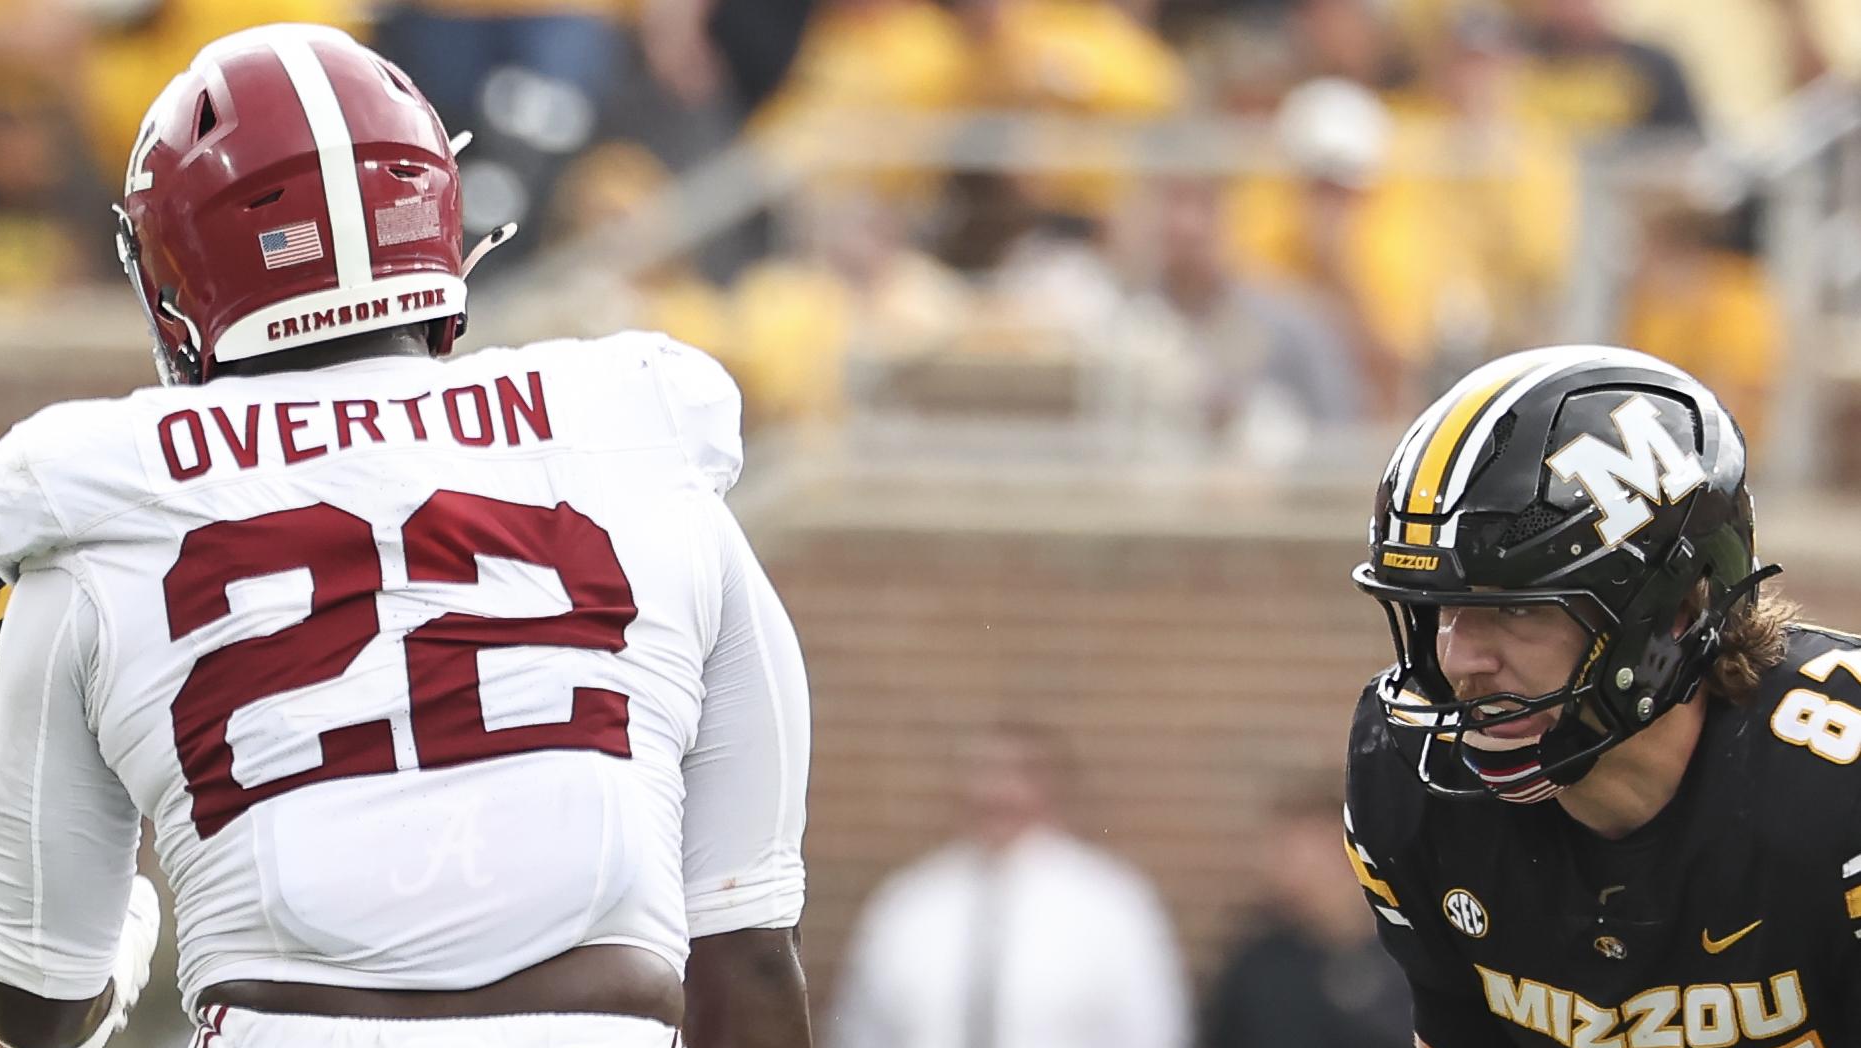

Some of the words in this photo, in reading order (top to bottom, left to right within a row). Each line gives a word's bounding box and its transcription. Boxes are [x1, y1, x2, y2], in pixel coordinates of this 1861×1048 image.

[267, 298, 389, 342] CRIMSON
[155, 371, 553, 482] OVERTON
[1545, 394, 1707, 549] M
[162, 488, 638, 841] 22
[1445, 891, 1487, 936] SEC
